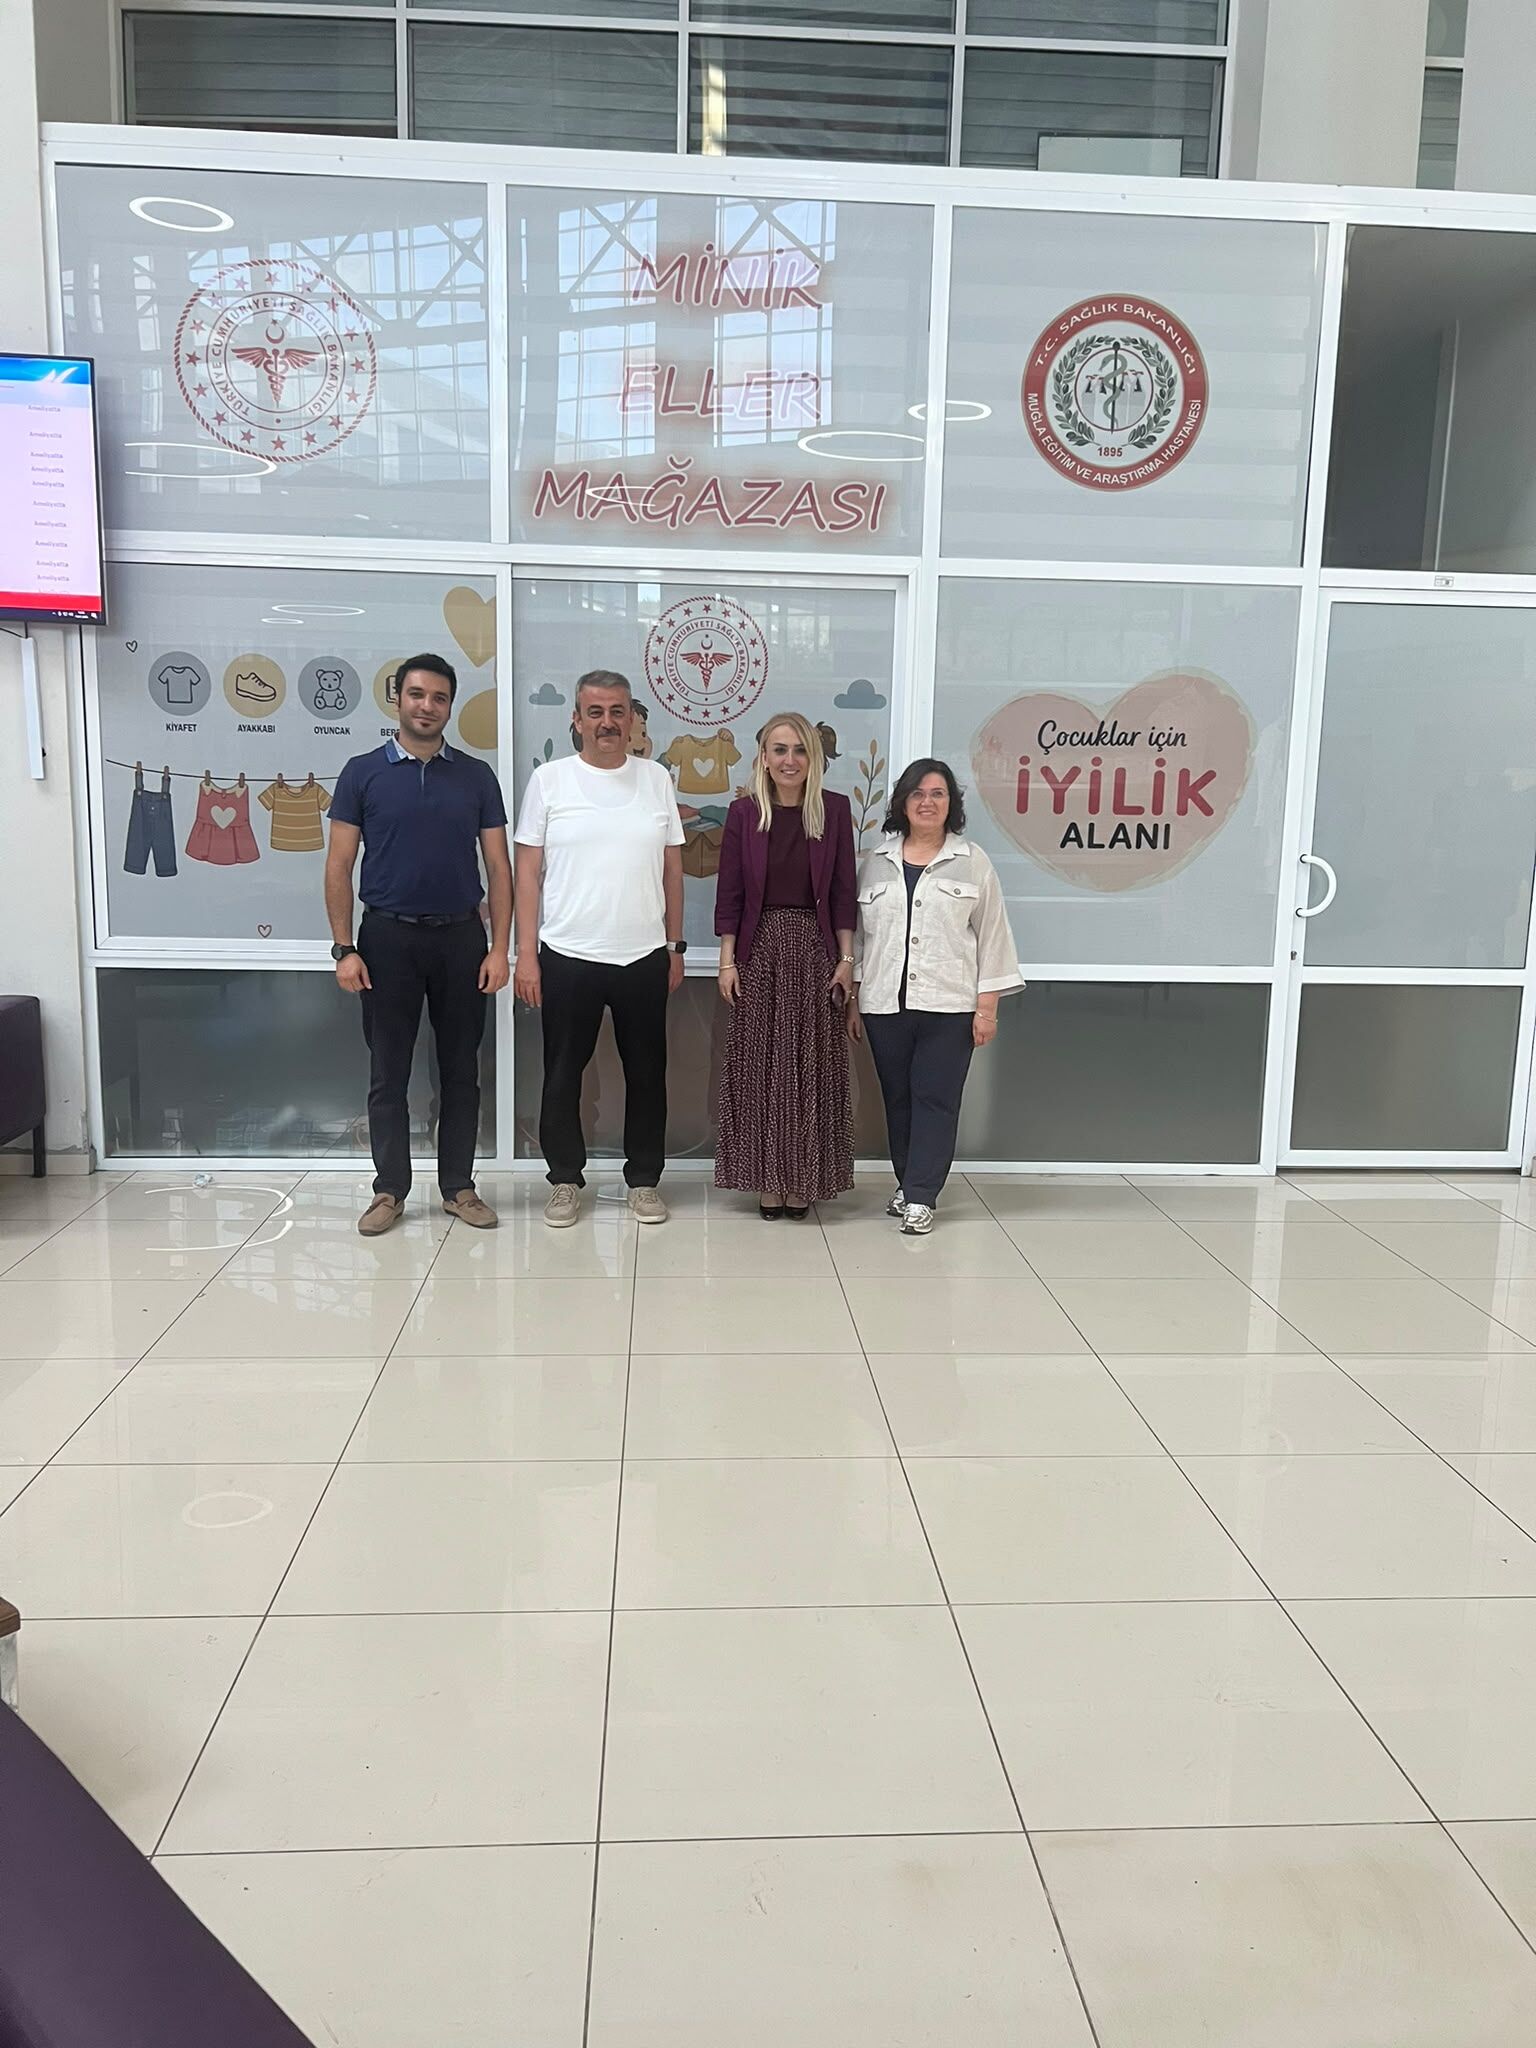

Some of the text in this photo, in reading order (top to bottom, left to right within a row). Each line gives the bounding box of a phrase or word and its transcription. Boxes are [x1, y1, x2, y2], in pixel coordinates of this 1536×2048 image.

[632, 243, 823, 309] MİNİK
[1034, 303, 1196, 375] T.C. SAĞLIK BAKANLIĞI
[308, 344, 339, 416] BAKANLIĞI
[619, 364, 822, 420] ELLER
[1027, 392, 1202, 486] MUĞLA EĞİTİM VE ARAŞTIRMA HASTANESİ
[1097, 446, 1123, 457] 1895
[534, 455, 886, 531] MAĞAZASI
[725, 649, 745, 697] BAKANLIĞI
[237, 723, 276, 733] AYAKKABI
[313, 725, 351, 736] OYUNCAK
[1037, 719, 1188, 755] Çocuklar için
[1016, 755, 1217, 817] İYİLİK
[1060, 822, 1171, 850] ALANI
